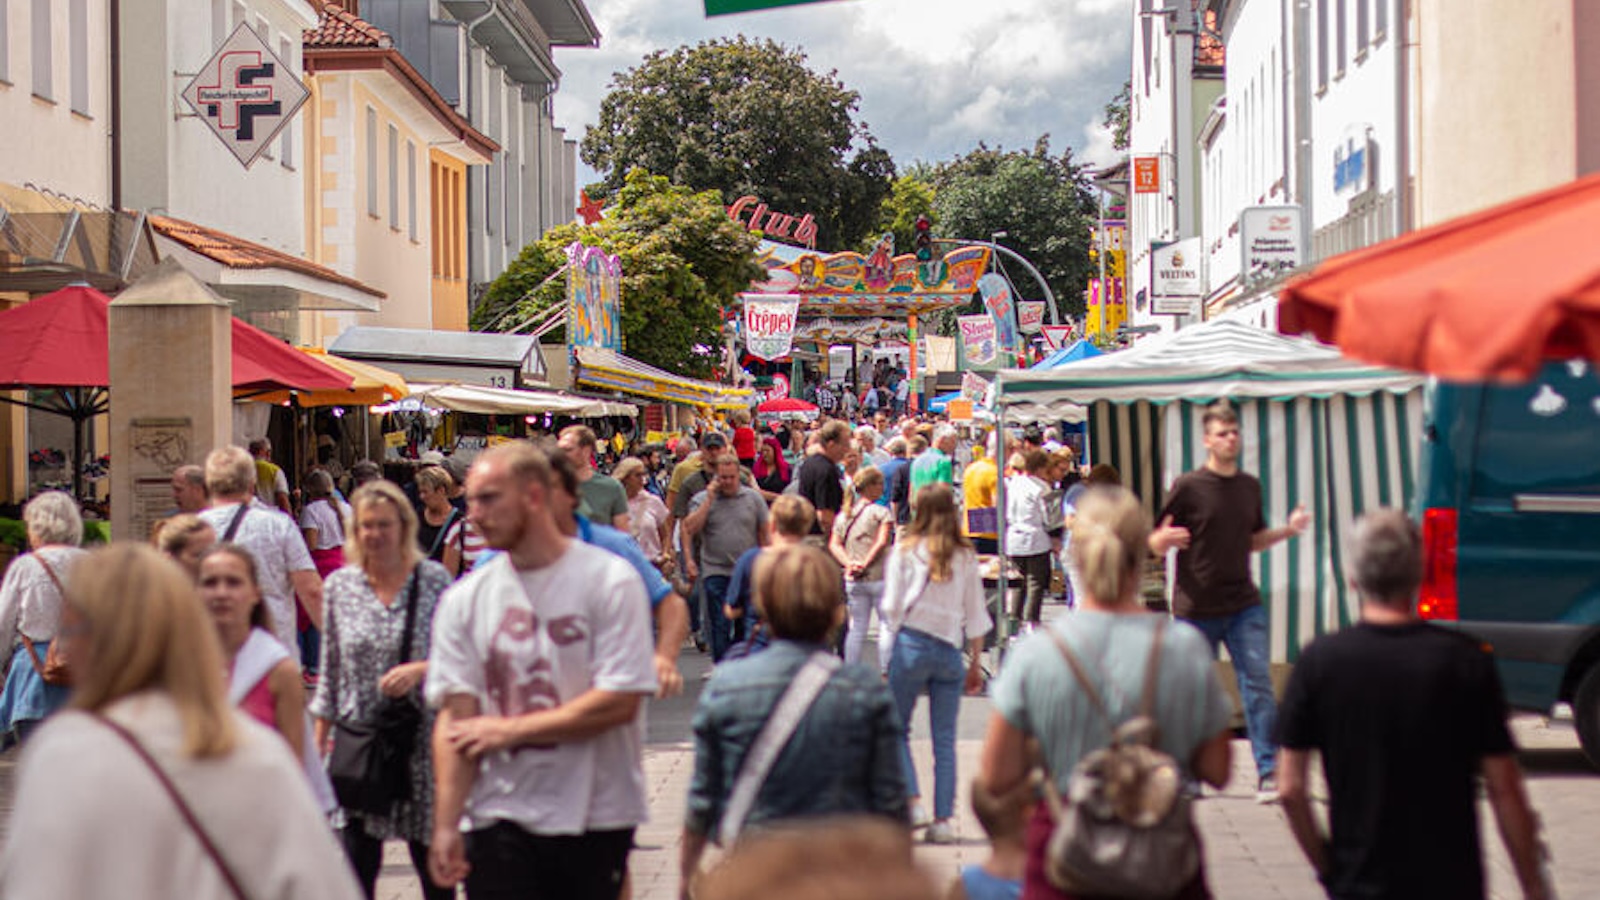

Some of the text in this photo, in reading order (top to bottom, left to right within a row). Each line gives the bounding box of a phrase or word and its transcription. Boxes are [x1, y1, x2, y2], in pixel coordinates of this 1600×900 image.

[1141, 171, 1154, 185] 12
[727, 194, 818, 243] Club
[748, 307, 793, 336] Crêpes
[490, 375, 506, 389] 13
